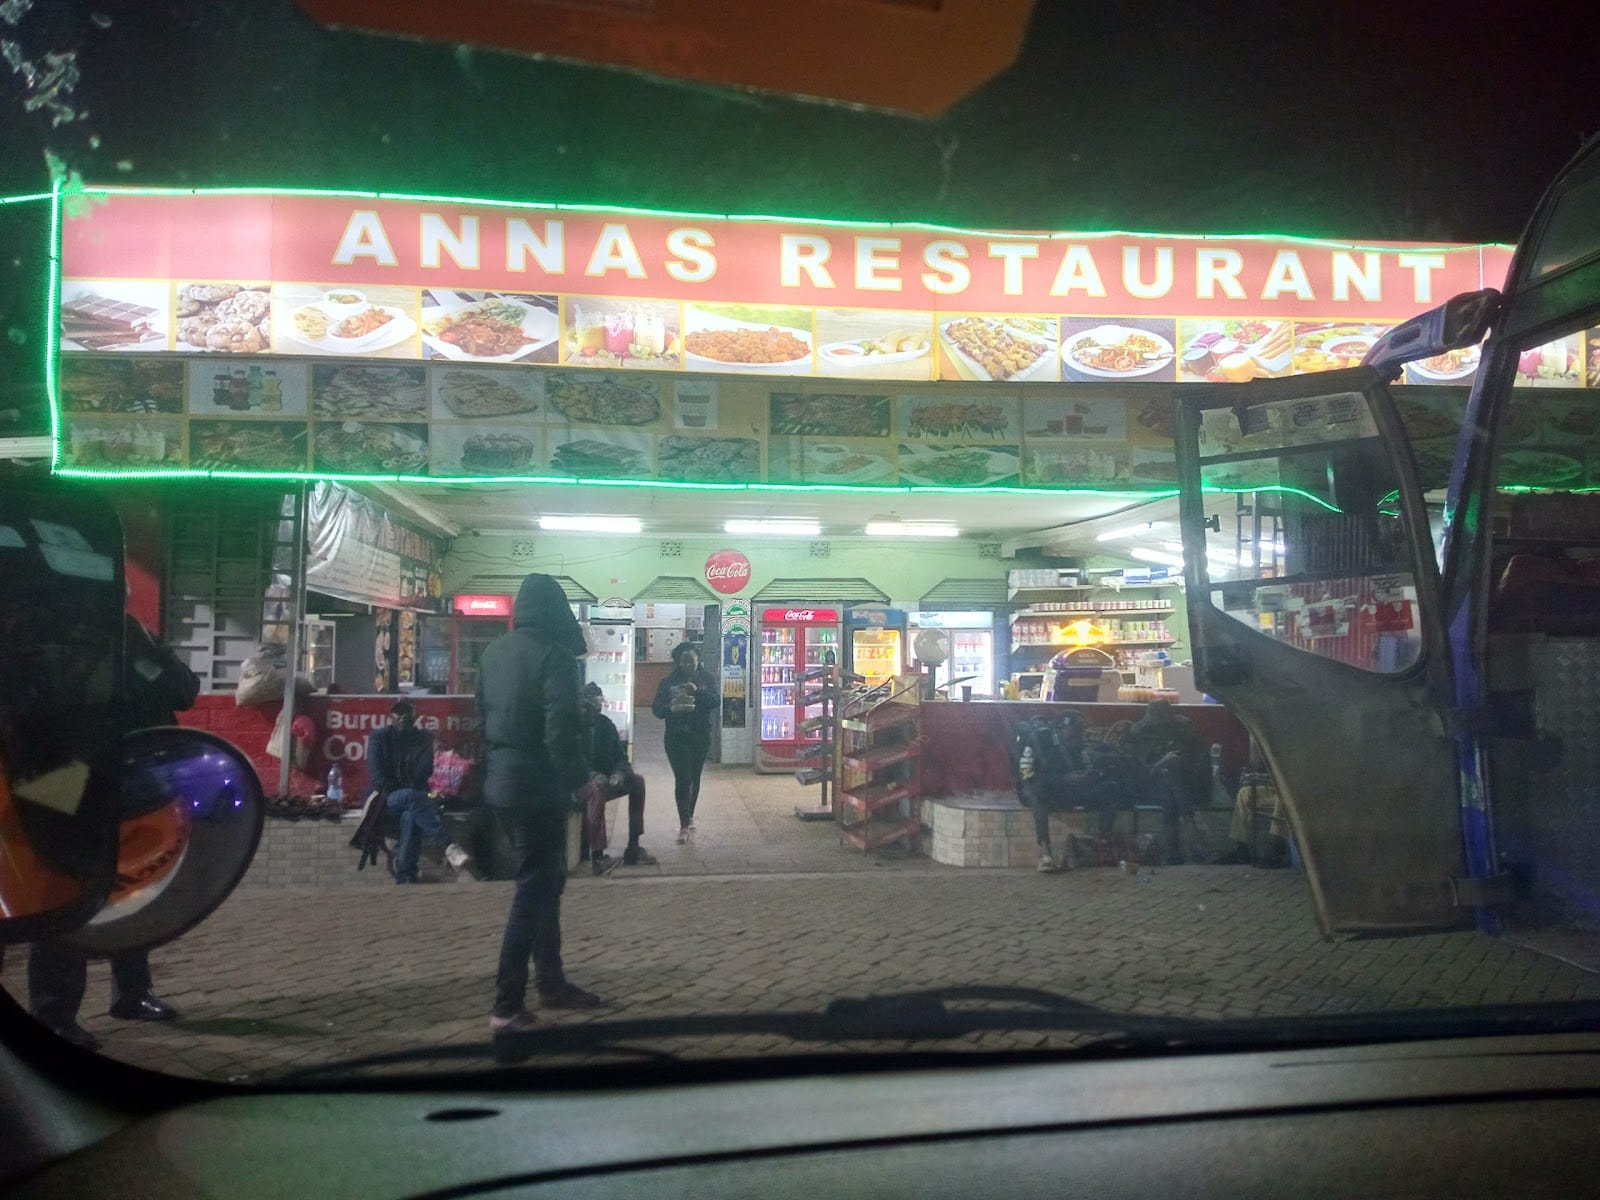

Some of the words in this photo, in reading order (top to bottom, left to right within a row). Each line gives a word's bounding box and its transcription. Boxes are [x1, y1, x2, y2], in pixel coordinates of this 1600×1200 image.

[331, 209, 718, 283] ANNAS
[779, 233, 1447, 303] RESTAURANT
[706, 562, 749, 580] Coca-Cola
[325, 709, 440, 730] Buruka
